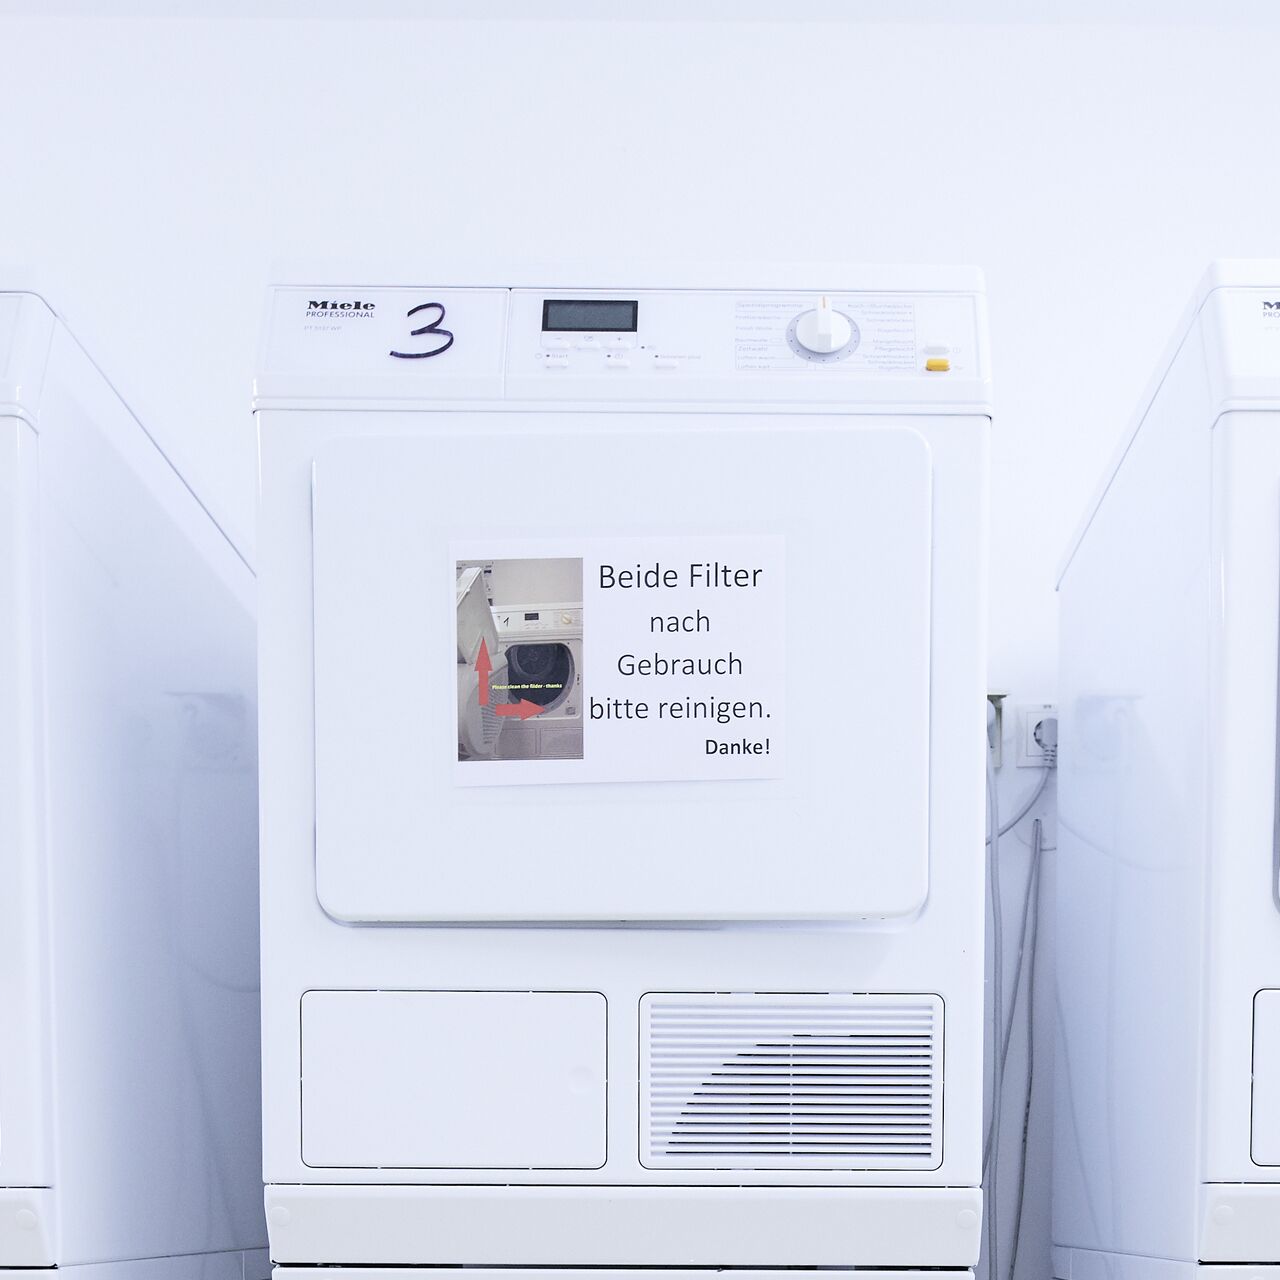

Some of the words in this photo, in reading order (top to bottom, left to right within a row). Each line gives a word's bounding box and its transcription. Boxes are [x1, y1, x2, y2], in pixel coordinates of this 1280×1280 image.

[308, 301, 375, 310] Miele
[389, 302, 455, 360] 3
[600, 562, 678, 589] Beide
[690, 561, 763, 588] Filter
[650, 608, 710, 633] nach
[617, 651, 742, 676] Gebrauch
[590, 696, 649, 720] bitte
[659, 696, 771, 724] reinigen.
[705, 738, 770, 755] Danke!
